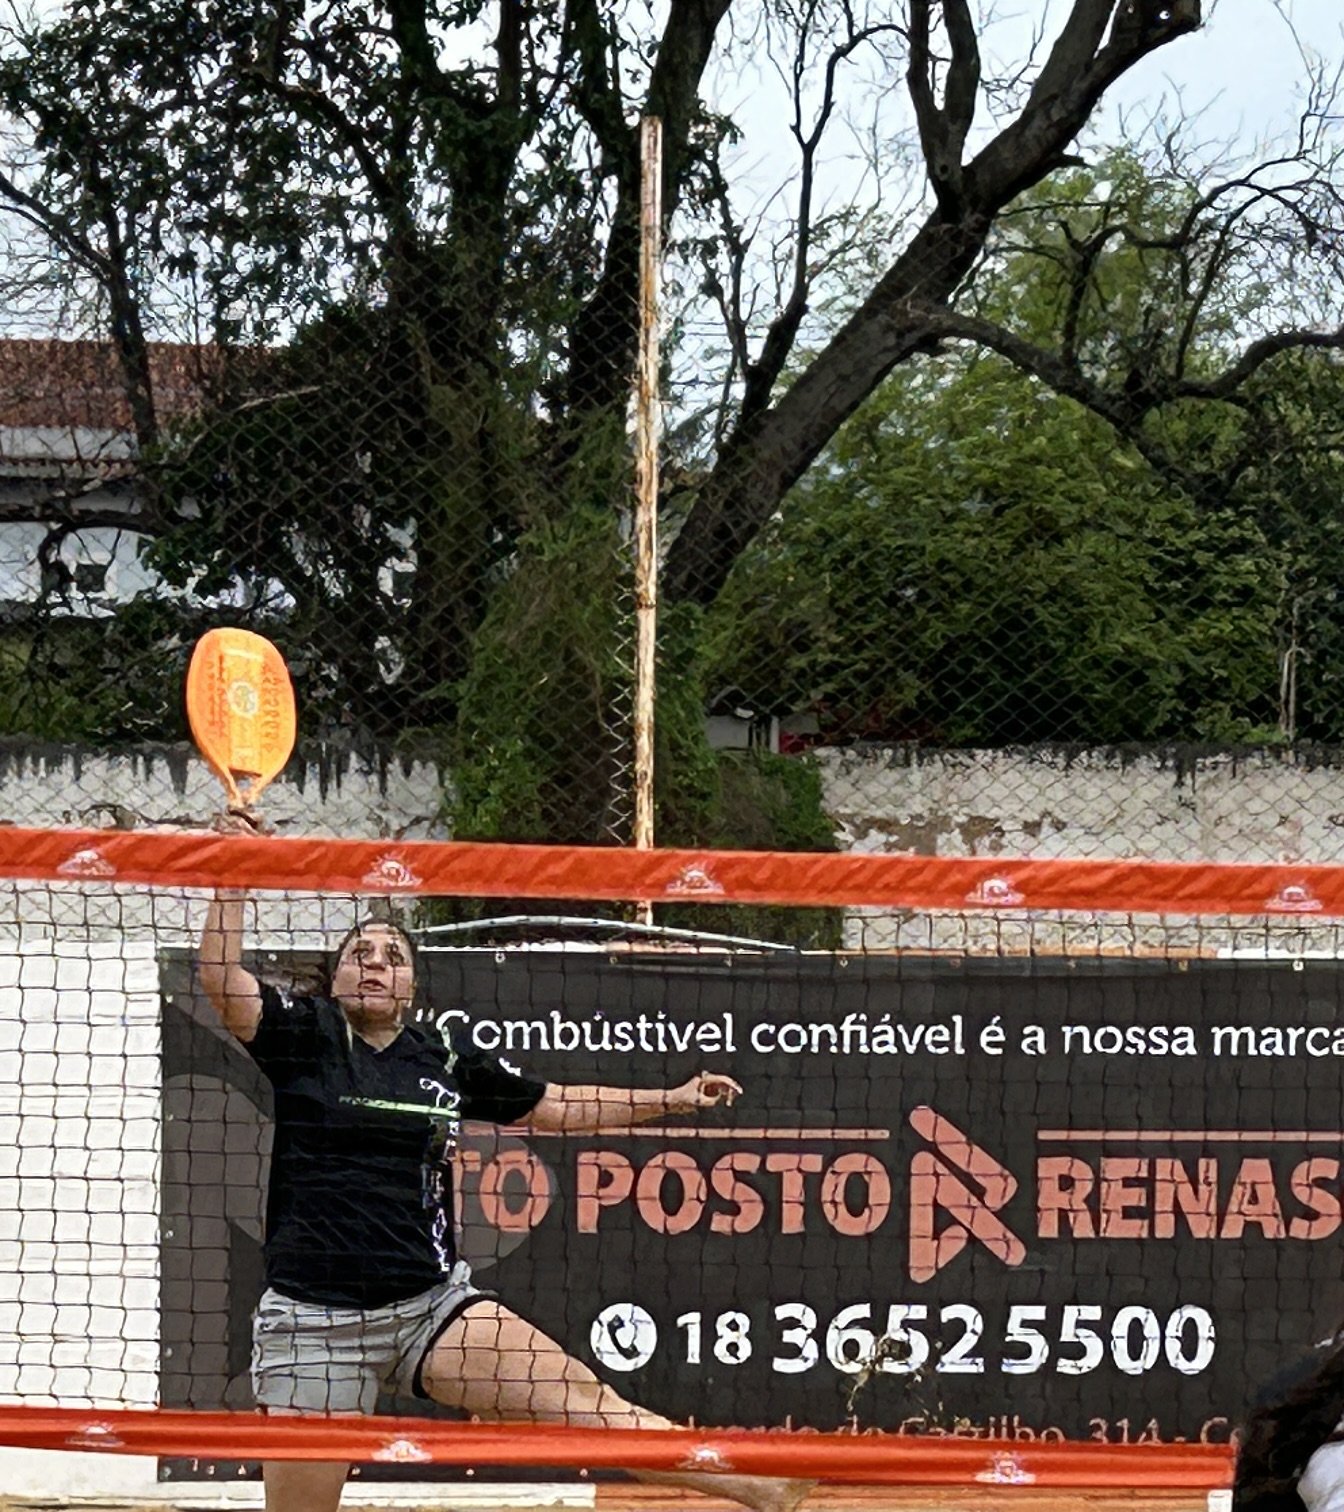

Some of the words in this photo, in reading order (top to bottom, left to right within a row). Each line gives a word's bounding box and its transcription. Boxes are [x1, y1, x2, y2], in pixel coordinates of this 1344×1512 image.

[751, 1013, 966, 1055] confiável
[980, 1015, 1006, 1055] é
[1021, 1024, 1047, 1056] a
[1061, 1024, 1198, 1056] nossa
[453, 1150, 551, 1233] TO
[577, 1150, 892, 1235] POSTO
[676, 1311, 753, 1365] 18
[772, 1303, 985, 1374] 3652
[1001, 1303, 1216, 1375] 5500
